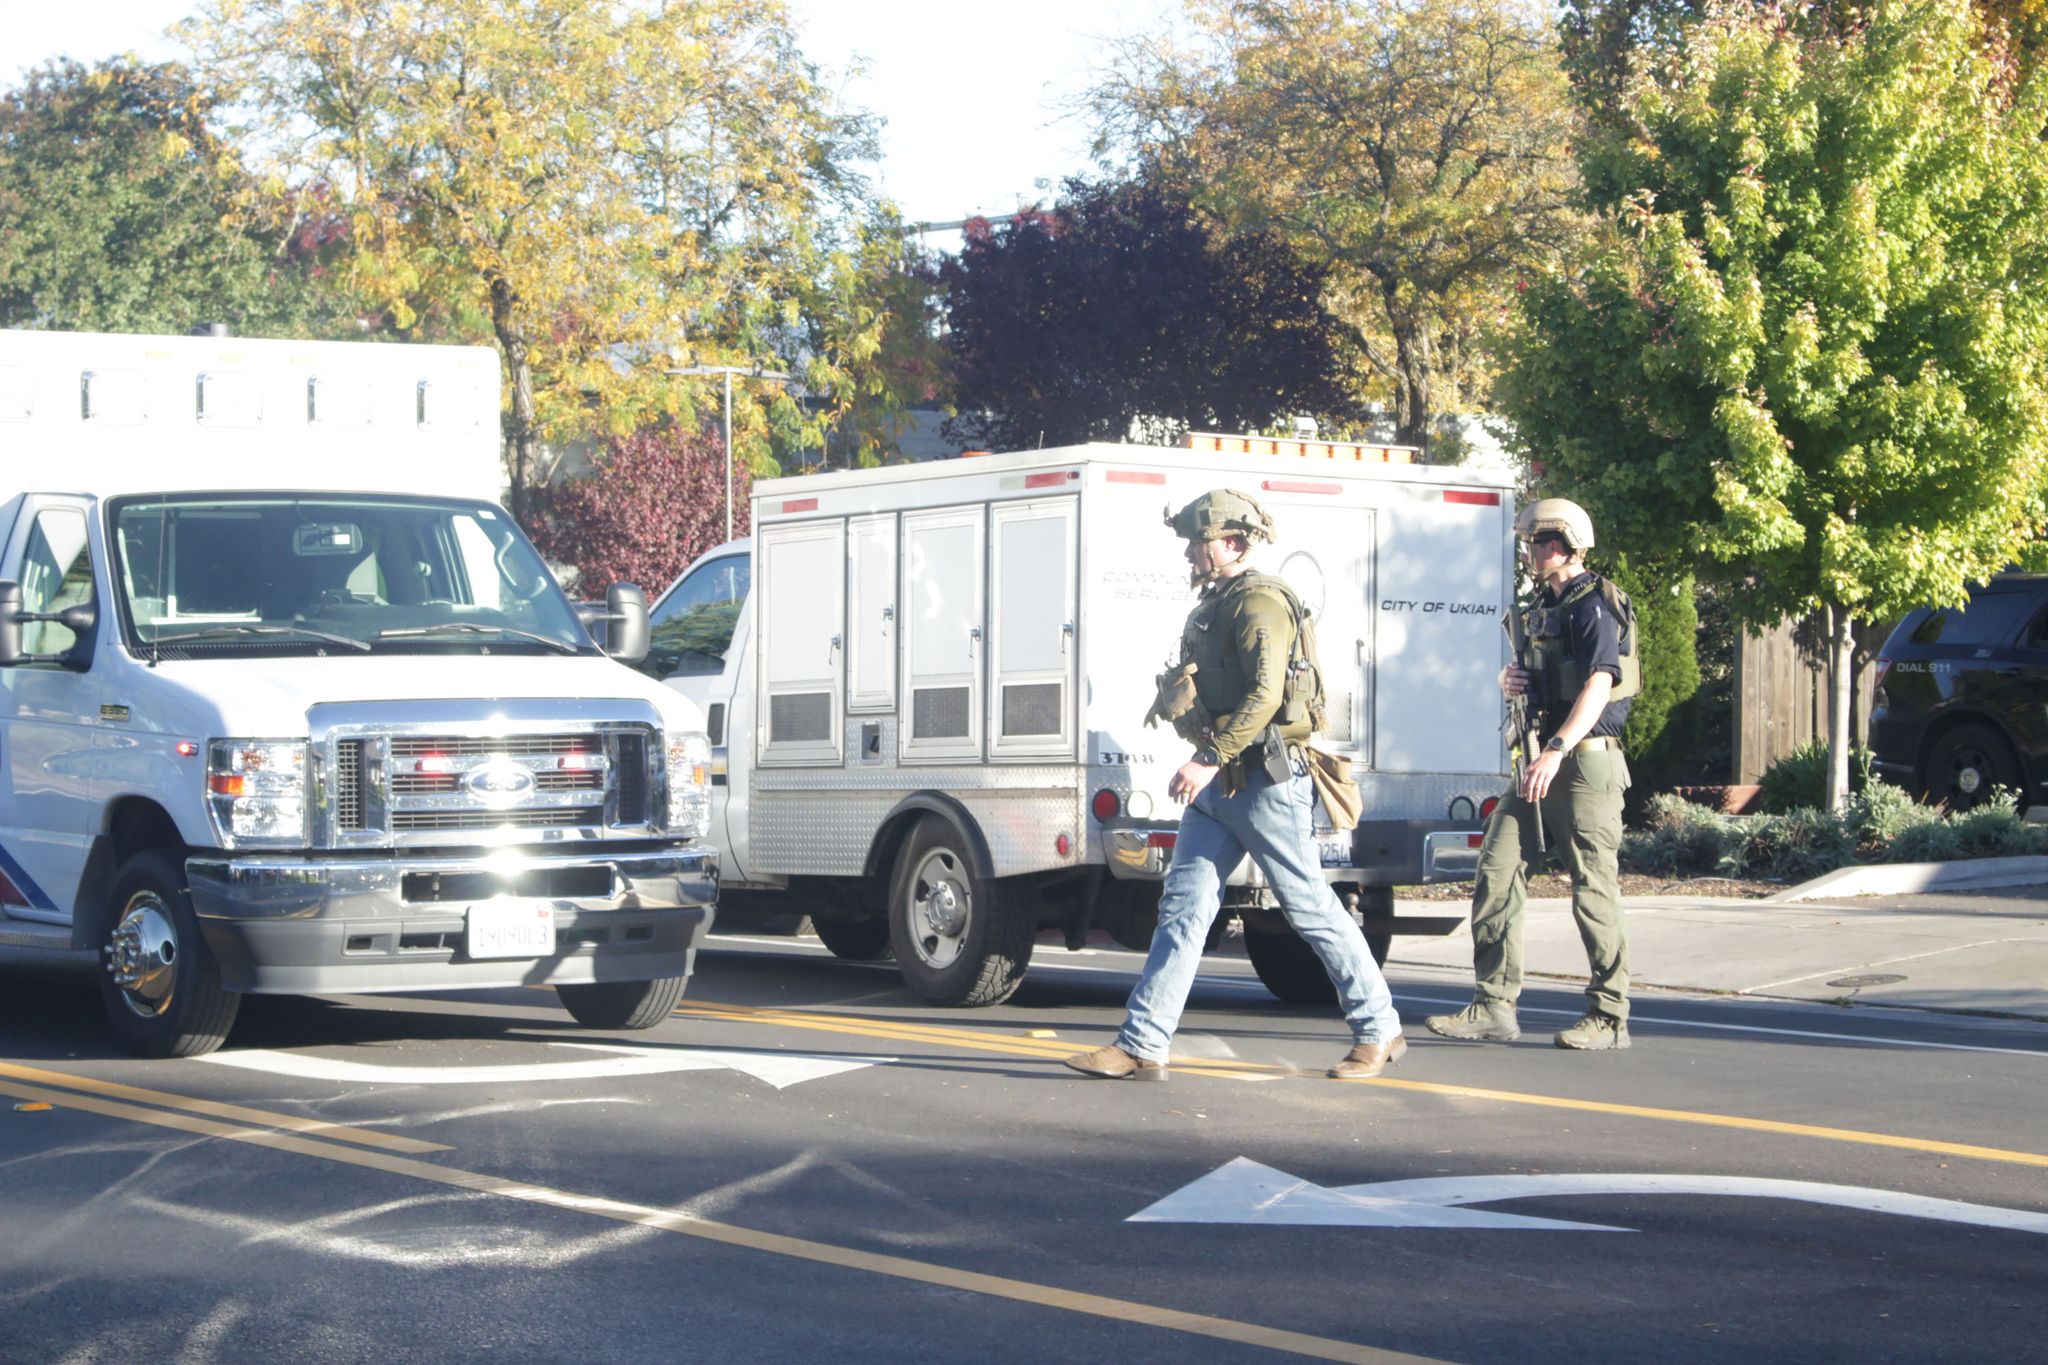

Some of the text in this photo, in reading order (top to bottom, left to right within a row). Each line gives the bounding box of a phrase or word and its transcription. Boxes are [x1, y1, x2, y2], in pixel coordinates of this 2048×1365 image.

[1381, 600, 1497, 616] CITY OF UKIAH
[1896, 663, 1951, 673] DIAL 911
